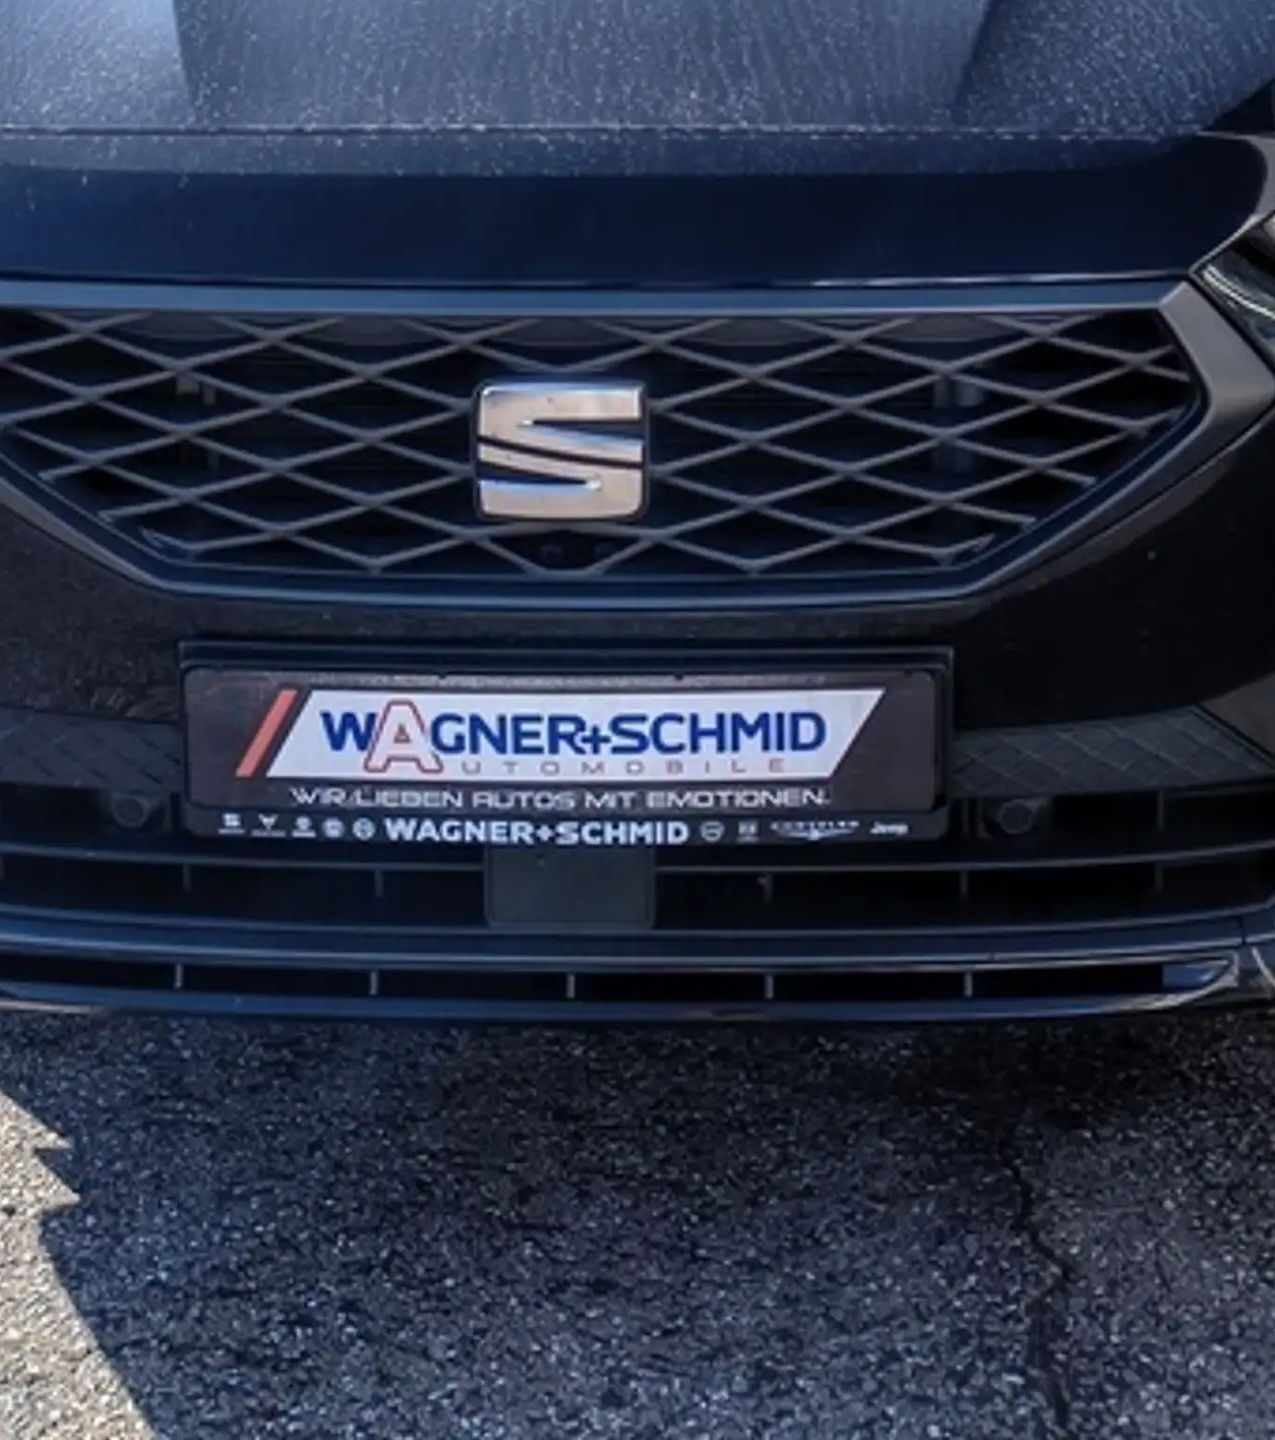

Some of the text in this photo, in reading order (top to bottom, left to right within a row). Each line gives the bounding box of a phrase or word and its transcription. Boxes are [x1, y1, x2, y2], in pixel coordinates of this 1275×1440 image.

[320, 699, 827, 774] WAGNER+SCHMID
[472, 788, 576, 809] AUTOS
[584, 788, 636, 809] MIT
[384, 817, 690, 846] WAGNER+SCHMID
